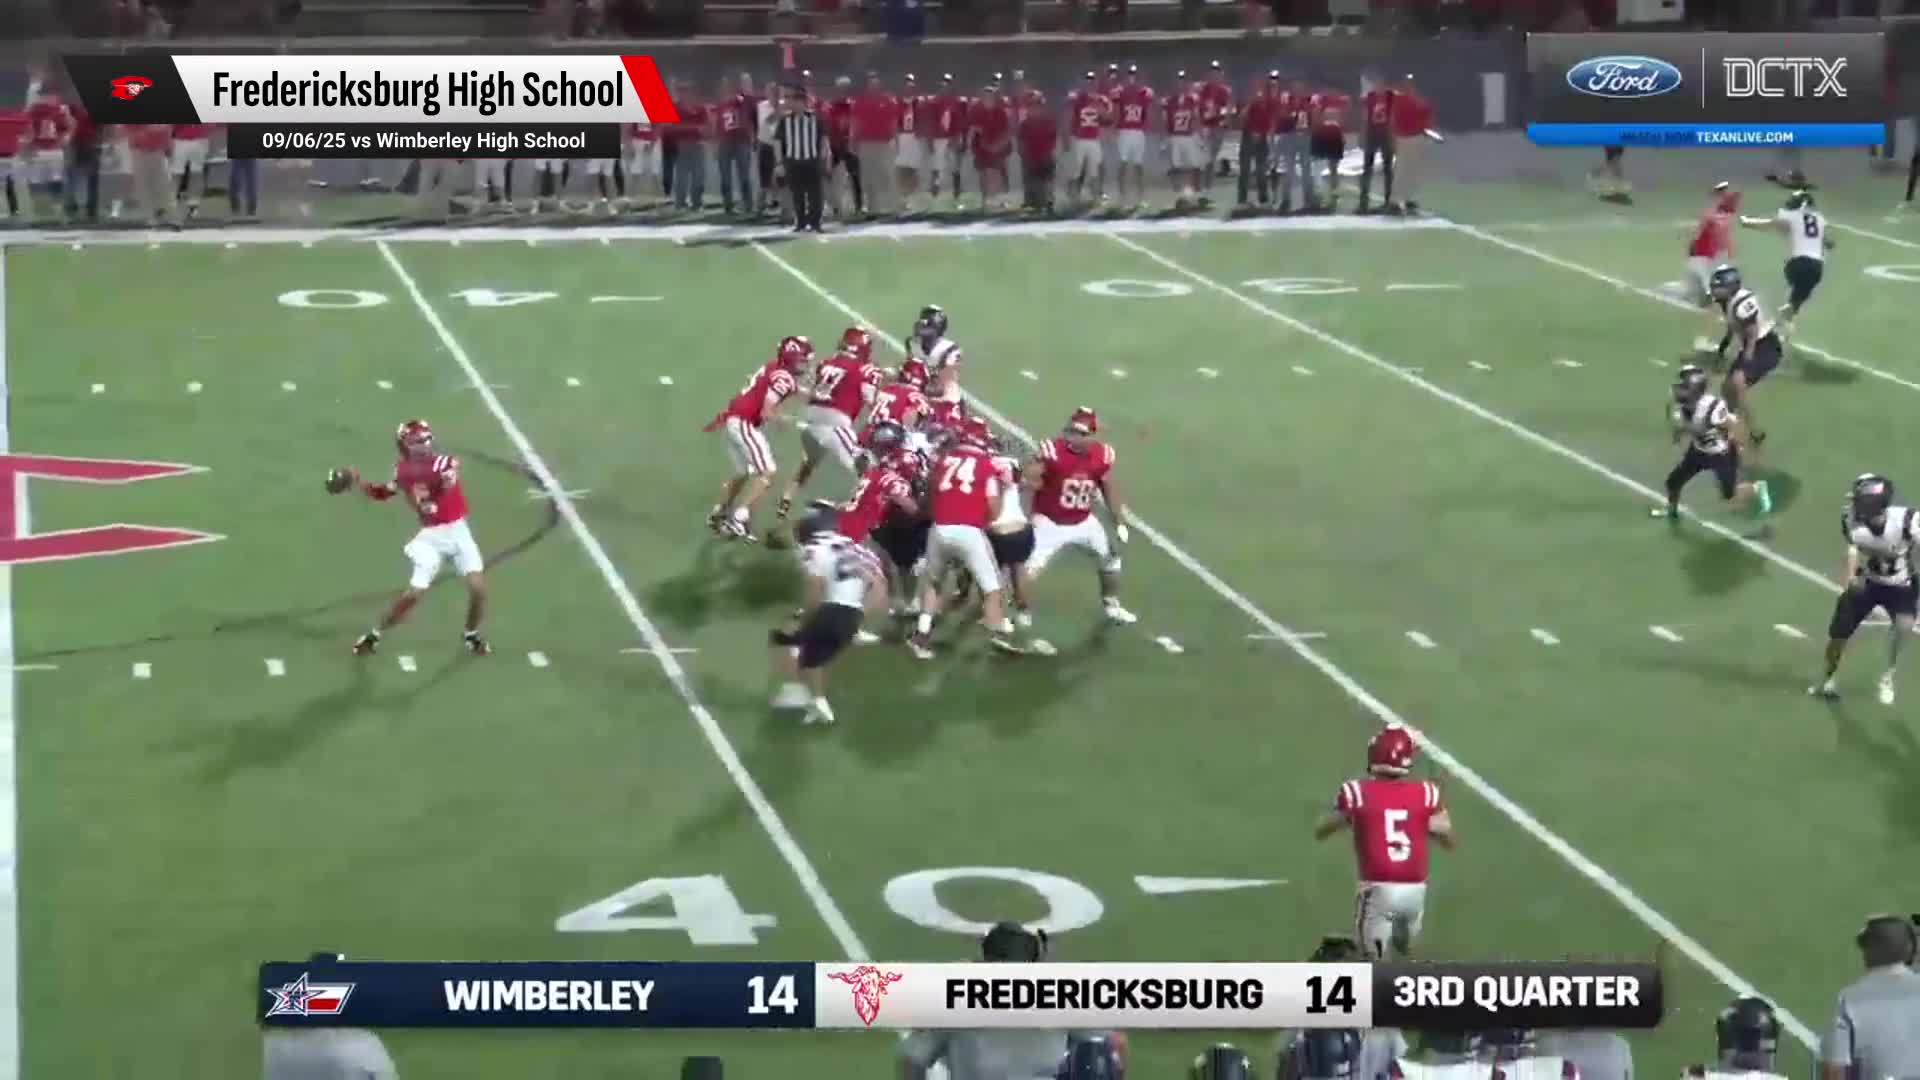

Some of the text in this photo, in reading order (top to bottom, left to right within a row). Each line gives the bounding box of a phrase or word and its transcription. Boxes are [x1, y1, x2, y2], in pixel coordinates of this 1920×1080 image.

[1802, 212, 1819, 239] 8
[938, 455, 977, 494] 74
[1384, 808, 1411, 862] 5
